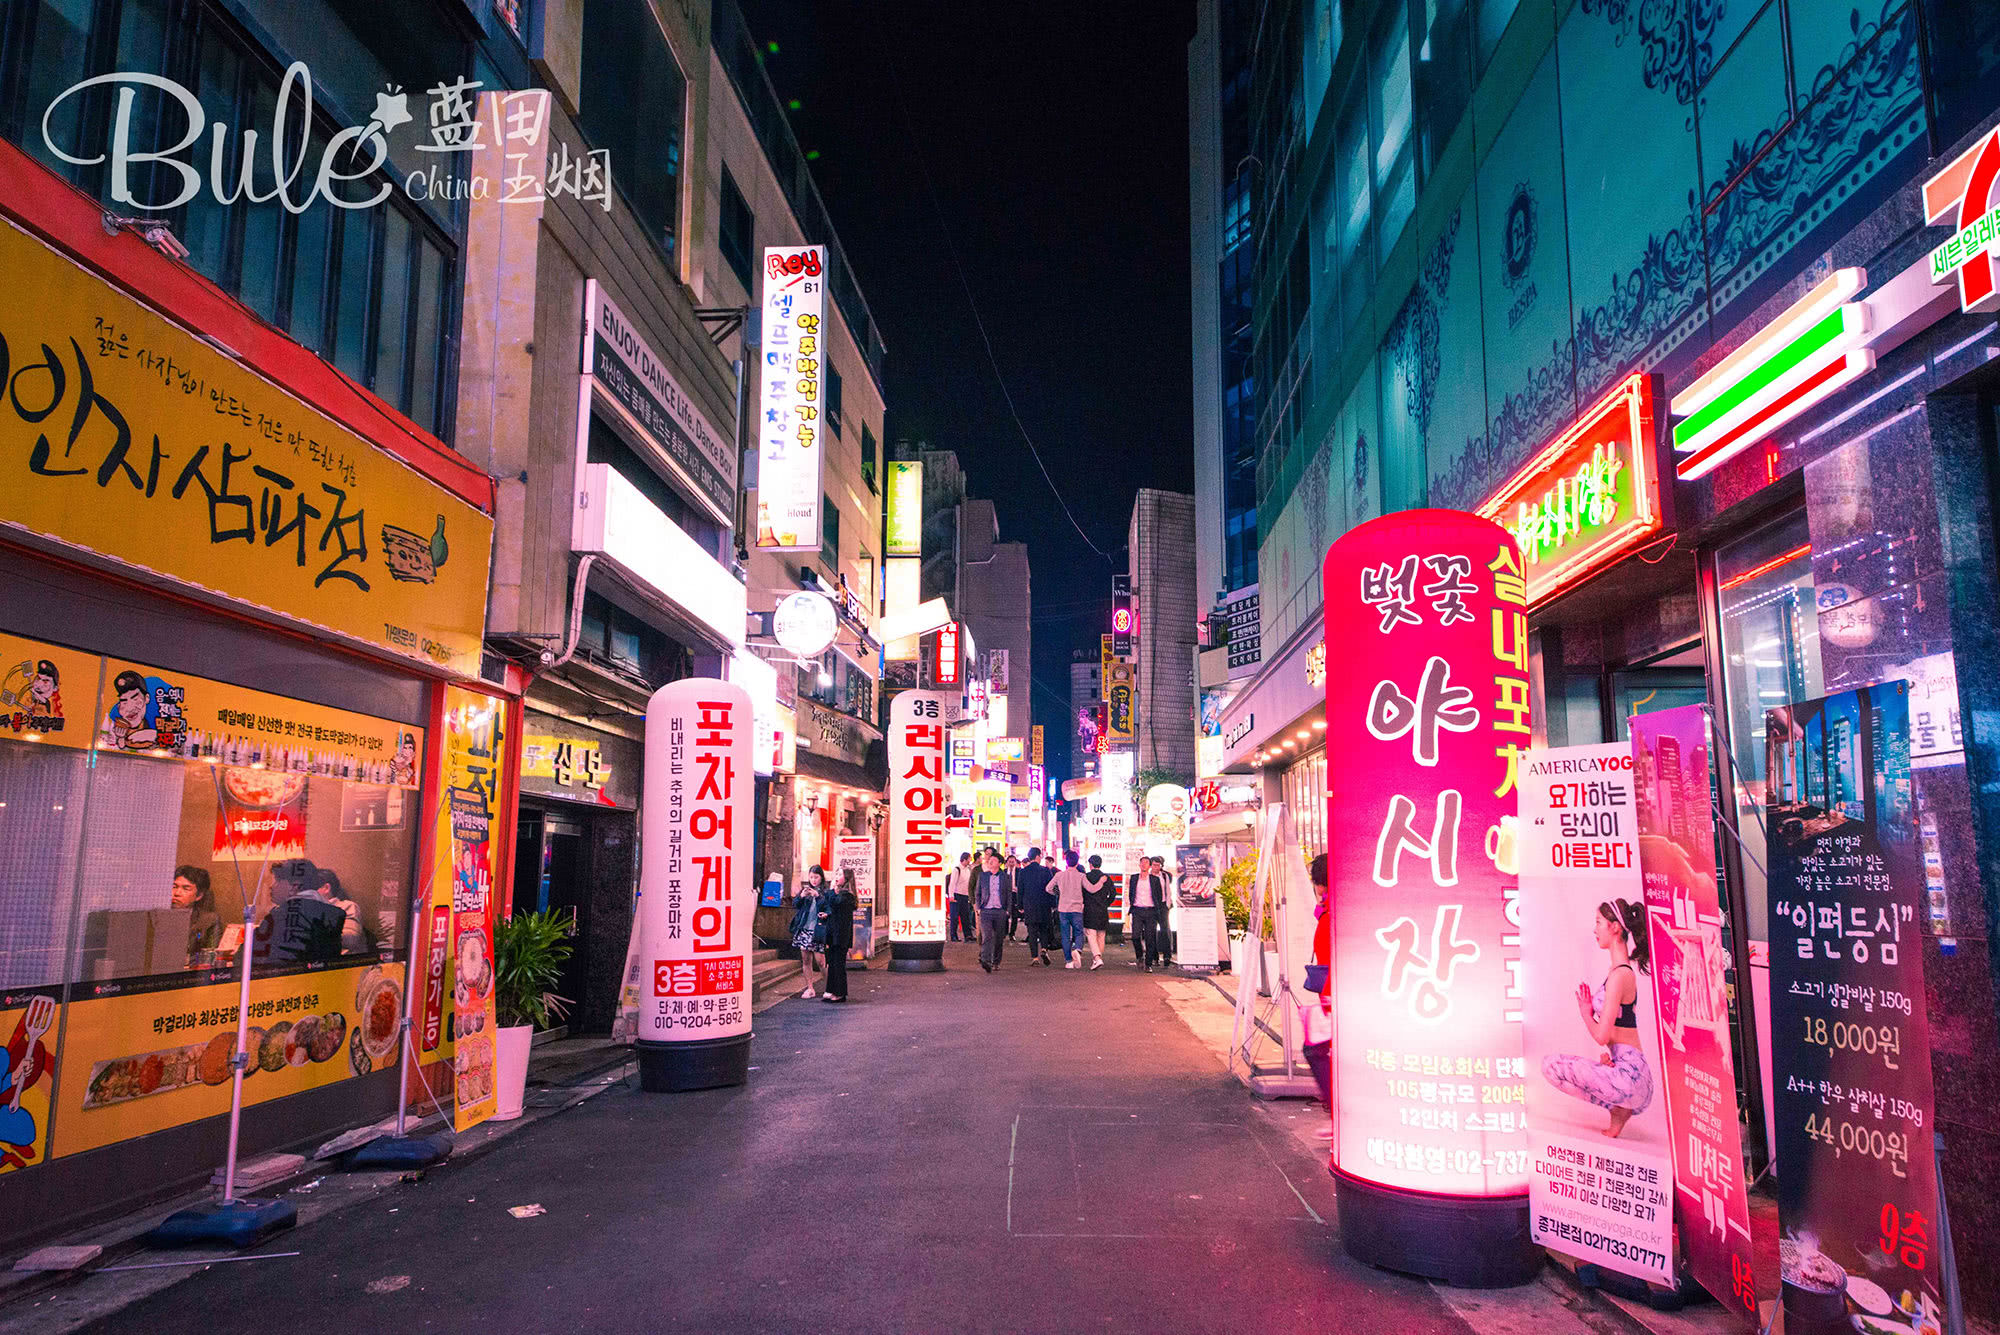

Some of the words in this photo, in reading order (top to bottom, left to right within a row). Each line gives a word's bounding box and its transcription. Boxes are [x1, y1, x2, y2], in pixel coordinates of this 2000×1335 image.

[767, 250, 821, 279] Rey
[1933, 208, 2000, 277] 세븐일레
[804, 283, 819, 293] B1
[136, 348, 205, 398] 사장님이
[210, 388, 254, 428] 만드는
[600, 352, 631, 402] 자신있는
[603, 303, 641, 366] ENJOY
[641, 351, 676, 412] DANCE
[677, 394, 694, 433] Life.
[695, 418, 719, 462] Dance
[718, 447, 732, 480] Box
[1361, 554, 1479, 634] 벚꽃
[384, 622, 418, 650] 가맹문의
[217, 708, 255, 730] 매일매일
[257, 715, 283, 734] 신선한
[297, 723, 313, 739] 전국
[914, 700, 940, 718] 3층
[670, 717, 683, 774] 비내리는
[670, 780, 683, 824] 추억의
[902, 723, 944, 911] 러시아도우미
[1093, 804, 1106, 813] UK
[1111, 804, 1123, 814] 75
[1549, 781, 1627, 808] 요가하는
[689, 701, 735, 953] 포차어게인
[1366, 656, 1481, 1024] 야시장
[1560, 812, 1619, 837] 당신이
[1835, 836, 1861, 853] 야경과
[669, 829, 682, 874] 길거리
[1552, 843, 1633, 868] 아름답다
[1801, 856, 1827, 872] 맛있는
[1829, 855, 1863, 867] 소고기가
[1865, 854, 1884, 872] 있는
[1795, 875, 1812, 891] 가장
[1815, 875, 1832, 891] 높은
[1835, 874, 1861, 886] 소고기
[1864, 873, 1893, 892] 전문점.
[668, 879, 682, 940] 포장마차
[427, 916, 447, 1041] 포장가능
[657, 962, 697, 994] 3층
[715, 981, 734, 991] 서비스
[1788, 980, 1824, 998] 소고기
[1827, 983, 1876, 1012] 생갈비살
[1879, 990, 1912, 1016] 150g
[153, 1010, 198, 1035] 막걸리와
[247, 997, 275, 1018] 다양한
[654, 1011, 743, 1029] 010-9204-5892
[1803, 1016, 1900, 1070] 18,000원
[1786, 1075, 1815, 1094] A++
[1819, 1080, 1845, 1105] 한우
[1848, 1088, 1886, 1120] 살치살
[1890, 1098, 1923, 1127] 150g
[1547, 1145, 1585, 1166] 여성전용
[1638, 1166, 1658, 1185] 전문
[1689, 1133, 1734, 1199] 마천루
[1804, 1112, 1908, 1179] 44,000원
[1535, 1160, 1574, 1182] 다이어트
[1577, 1170, 1595, 1187] 전문
[1605, 1178, 1645, 1201] 전문적인
[1649, 1188, 1668, 1208] 강사
[1549, 1181, 1577, 1200] 15가지
[1580, 1188, 1599, 1206] 이상
[1602, 1195, 1631, 1215] 다양한
[1635, 1204, 1655, 1222] 요가
[1538, 1215, 1582, 1244] 종각본점
[1584, 1230, 1666, 1271] 02)733.0777
[1542, 1200, 1663, 1246] www.americayoga.co.kr
[1880, 1203, 1929, 1271] 9층
[1731, 1253, 1755, 1313] 9층
